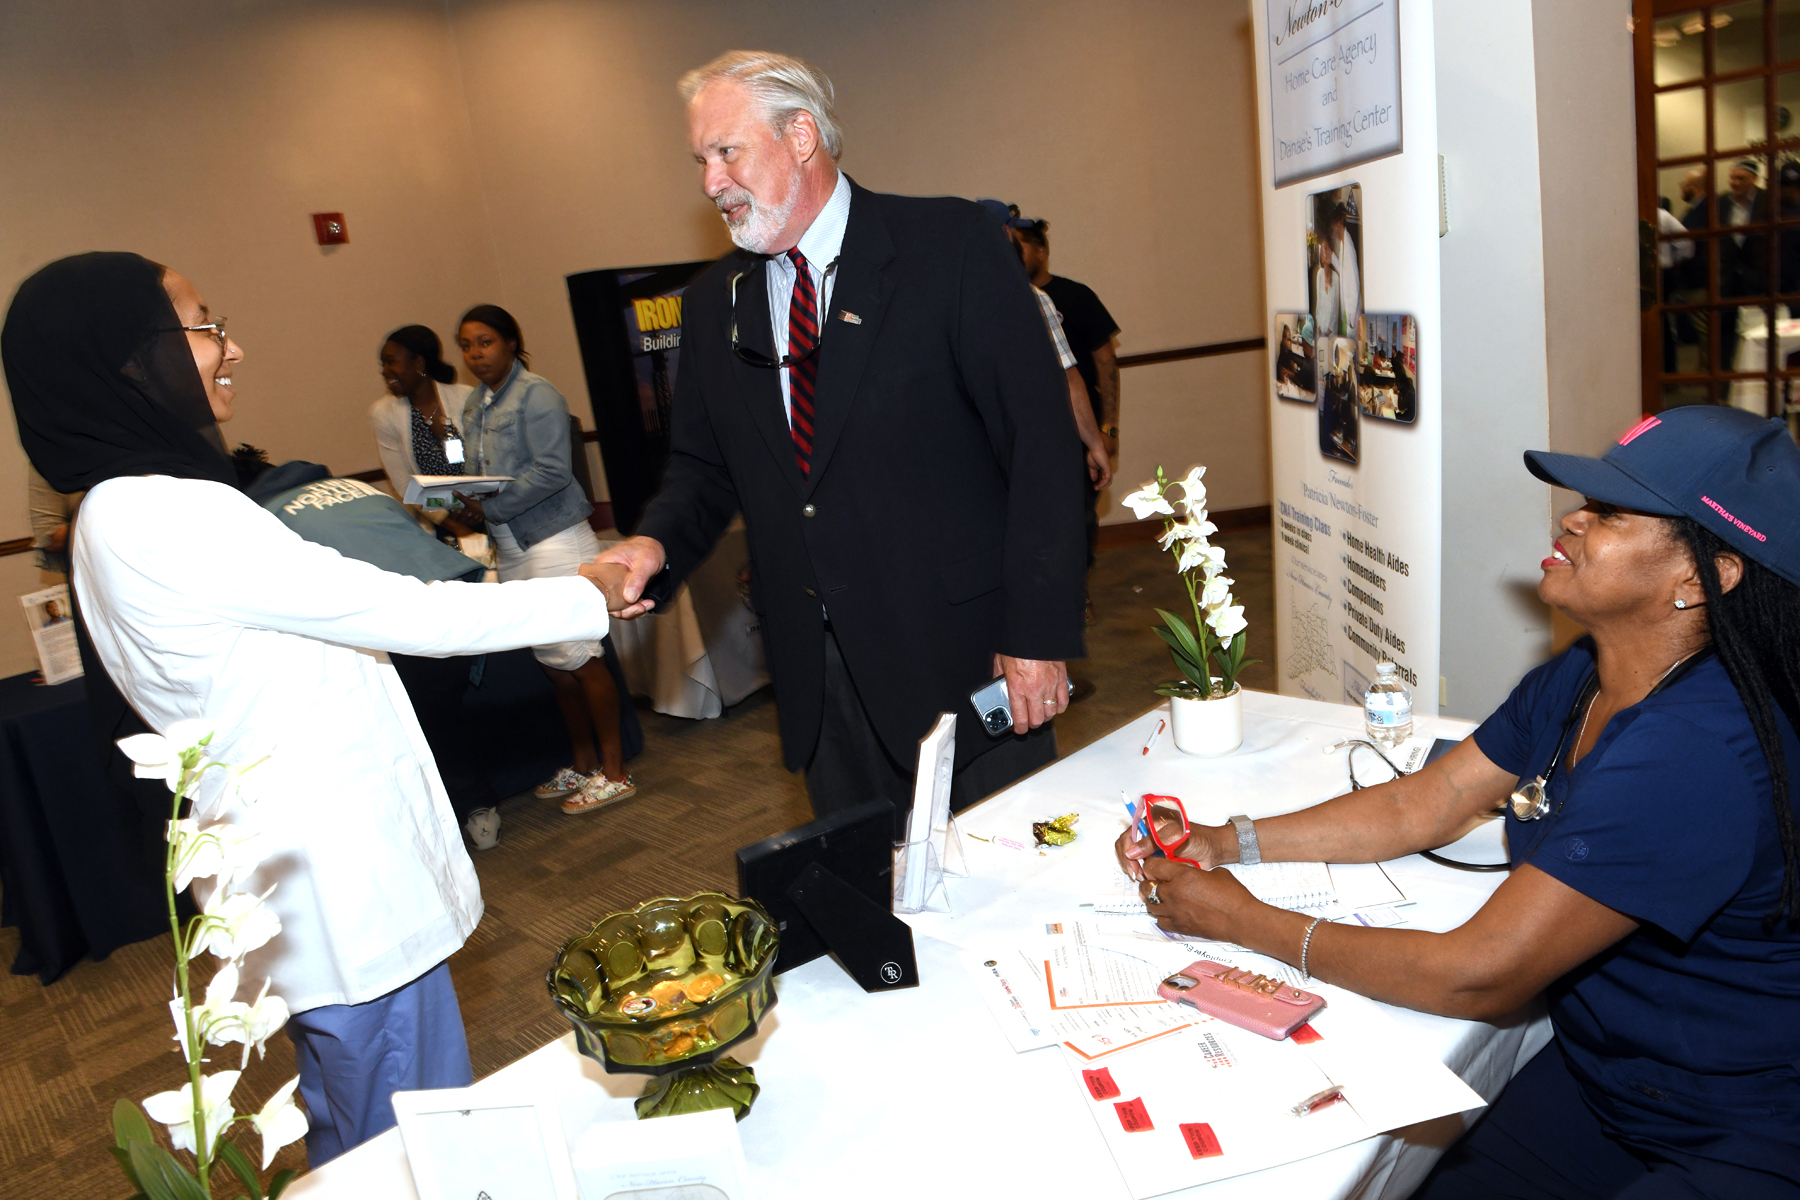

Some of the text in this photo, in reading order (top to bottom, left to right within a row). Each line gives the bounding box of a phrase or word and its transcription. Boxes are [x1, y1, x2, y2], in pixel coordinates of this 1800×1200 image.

[1285, 33, 1377, 94] Home Care Agency
[1322, 77, 1338, 106] and
[1279, 105, 1392, 161] Danae's Training Center
[283, 483, 361, 515] NORTH
[313, 489, 367, 510] FACE
[1329, 492, 1379, 529] Newton-Foster
[1292, 504, 1314, 532] Training
[1314, 516, 1332, 537] Class
[1301, 529, 1312, 542] class
[1701, 495, 1767, 543] MARTHA'S VINEYARD
[1347, 555, 1386, 591] Homemakers
[1364, 540, 1386, 566] Health
[1387, 553, 1409, 577] Aides
[1347, 579, 1384, 616] Companions
[1347, 603, 1406, 655] Private Duty Aides
[1347, 625, 1381, 664] Community
[1194, 949, 1233, 964] Employer
[1193, 1141, 1203, 1157] KEEP
[1195, 1129, 1208, 1153] COUPON
